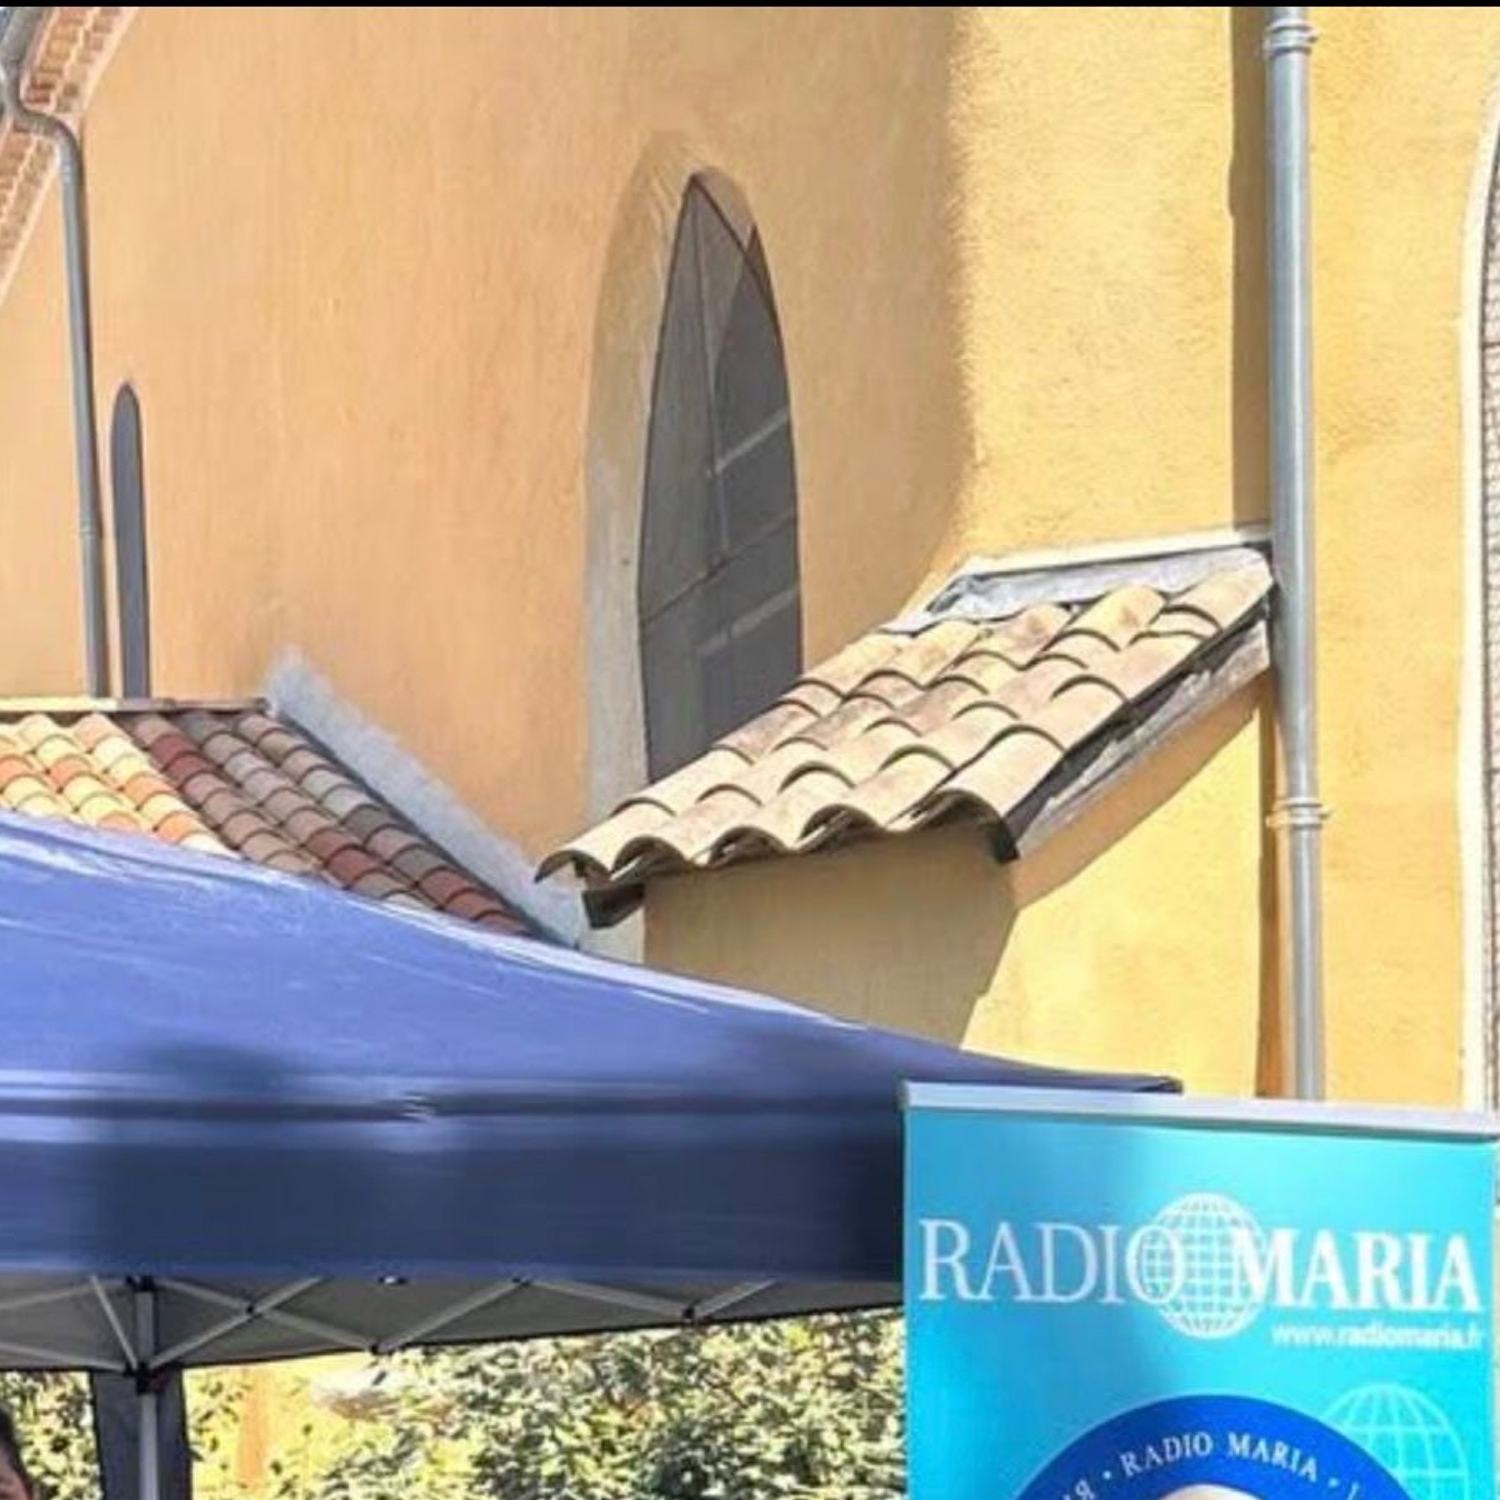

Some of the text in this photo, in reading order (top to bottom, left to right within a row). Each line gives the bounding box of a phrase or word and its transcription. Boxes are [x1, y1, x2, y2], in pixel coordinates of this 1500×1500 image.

[918, 1217, 1484, 1313] RADIO MARIA
[1120, 1431, 1319, 1482] RADIO MARIA
